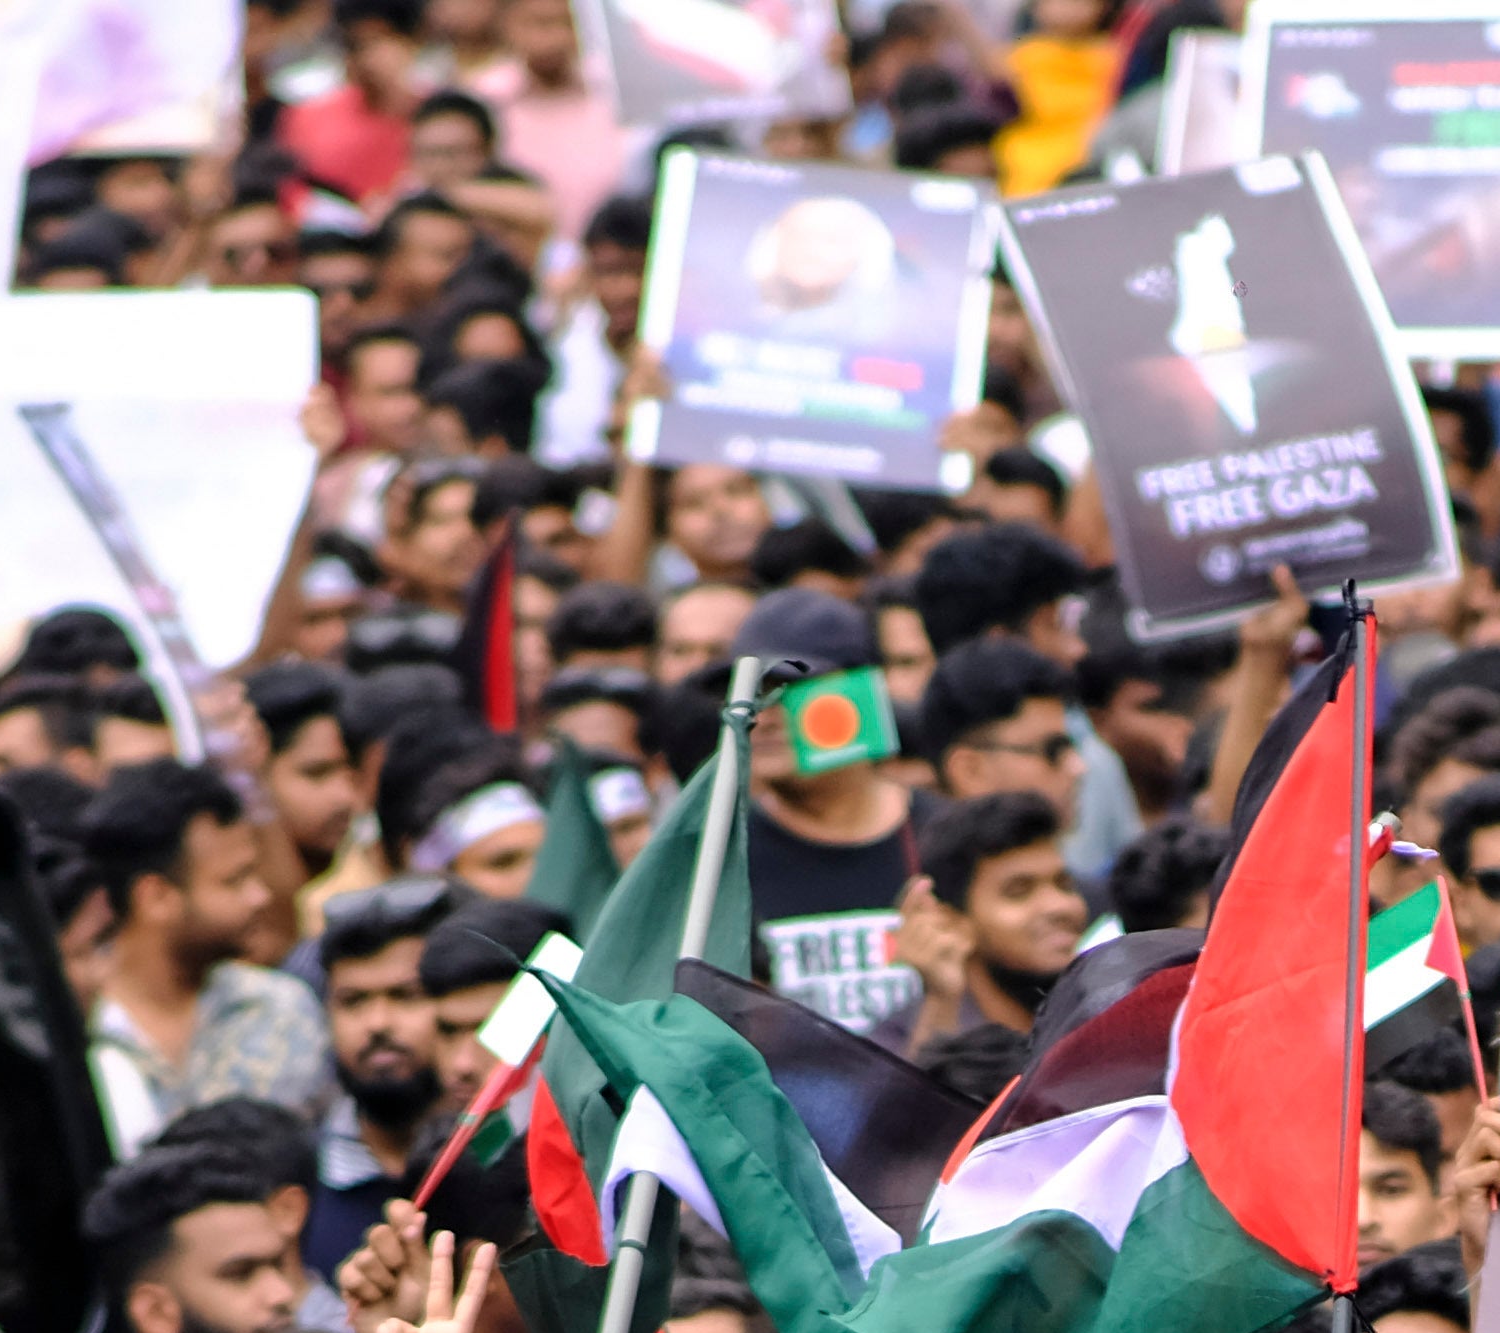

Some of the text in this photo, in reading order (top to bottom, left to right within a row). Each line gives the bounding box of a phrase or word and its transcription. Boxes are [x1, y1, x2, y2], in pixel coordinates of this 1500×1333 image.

[1138, 430, 1381, 498] FREE PALESTINE
[1170, 466, 1378, 539] FREE GAZA
